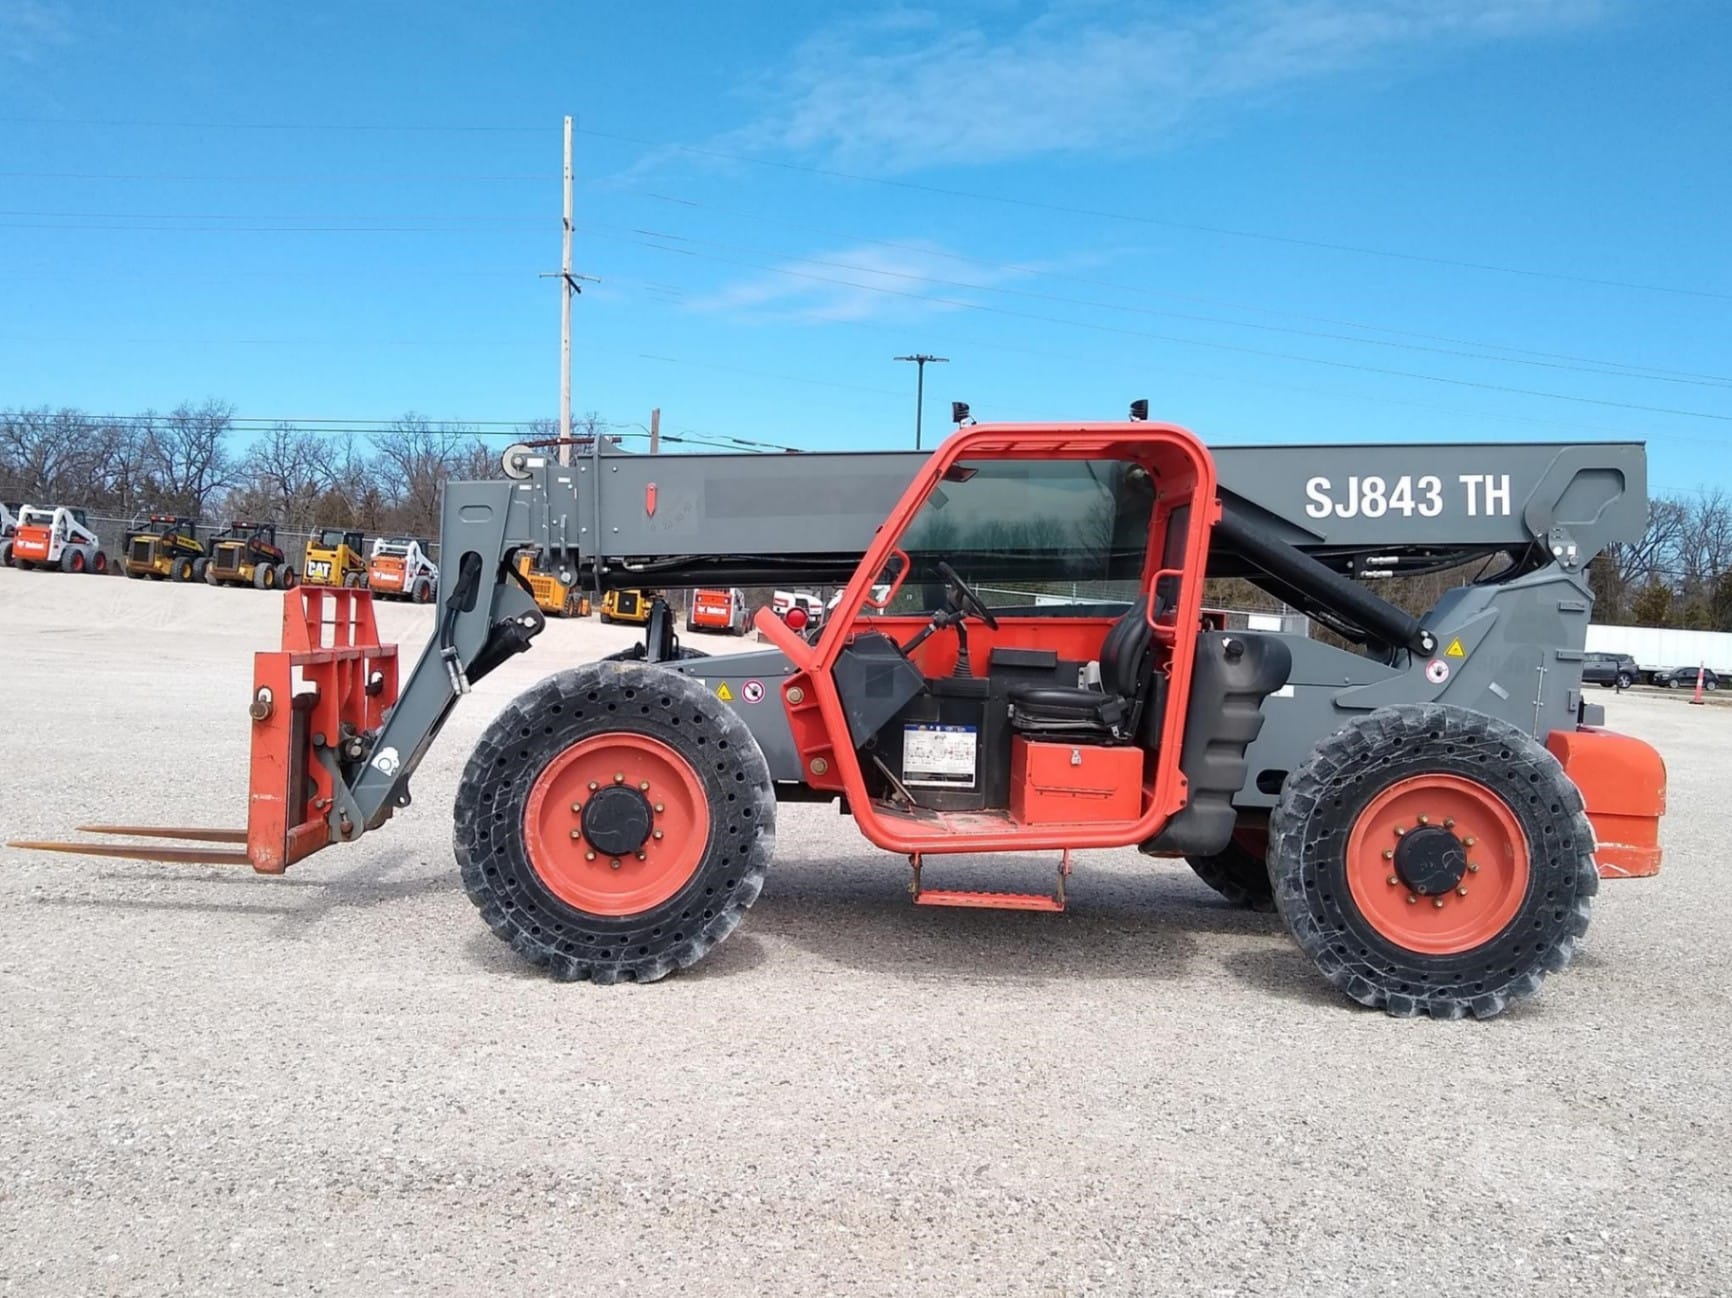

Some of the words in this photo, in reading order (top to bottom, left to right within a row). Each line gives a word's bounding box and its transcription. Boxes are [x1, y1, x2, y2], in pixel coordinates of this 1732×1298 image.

[1305, 475, 1443, 518] SJ843
[1458, 474, 1511, 516] TH
[308, 561, 331, 578] CAT
